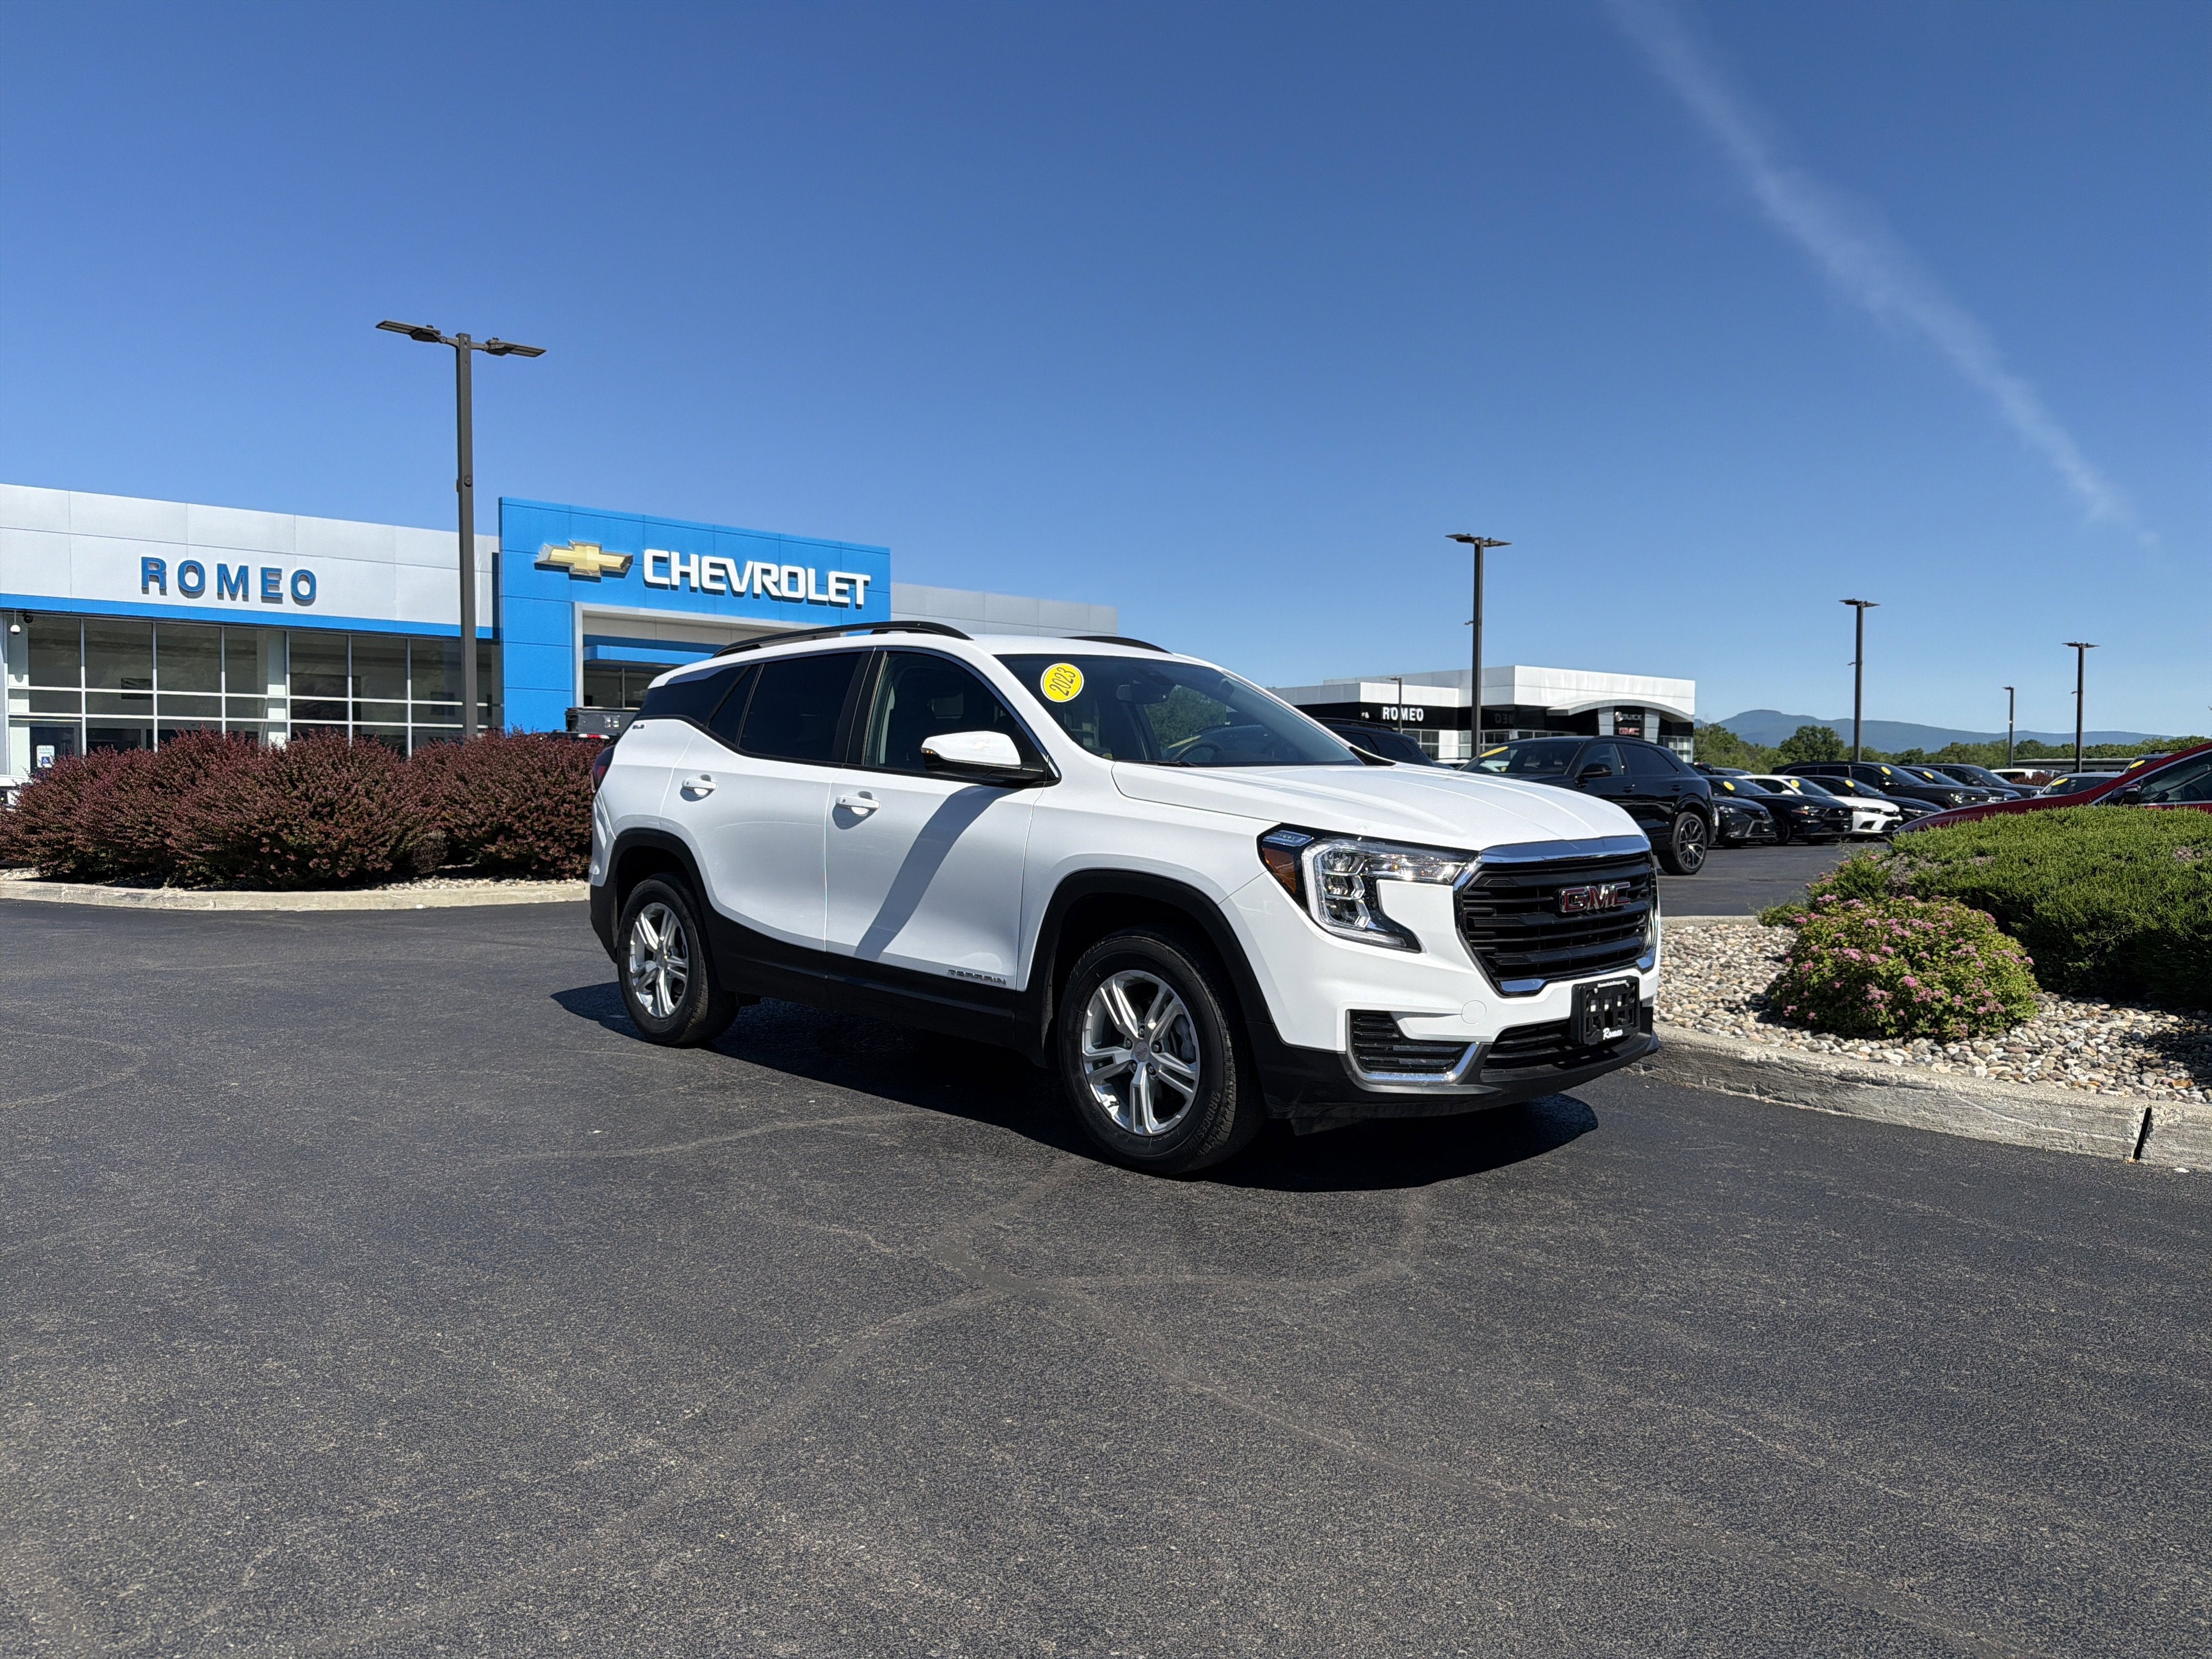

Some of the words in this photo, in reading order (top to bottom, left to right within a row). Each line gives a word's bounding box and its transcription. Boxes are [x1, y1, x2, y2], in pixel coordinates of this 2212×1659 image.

[141, 556, 317, 603] ROMEO
[644, 549, 871, 605] CHEVROLET
[1049, 667, 1076, 696] 2023
[1383, 706, 1424, 721] ROMEO
[1560, 881, 1630, 912] GMC
[1602, 1027, 1623, 1041] Romeo
